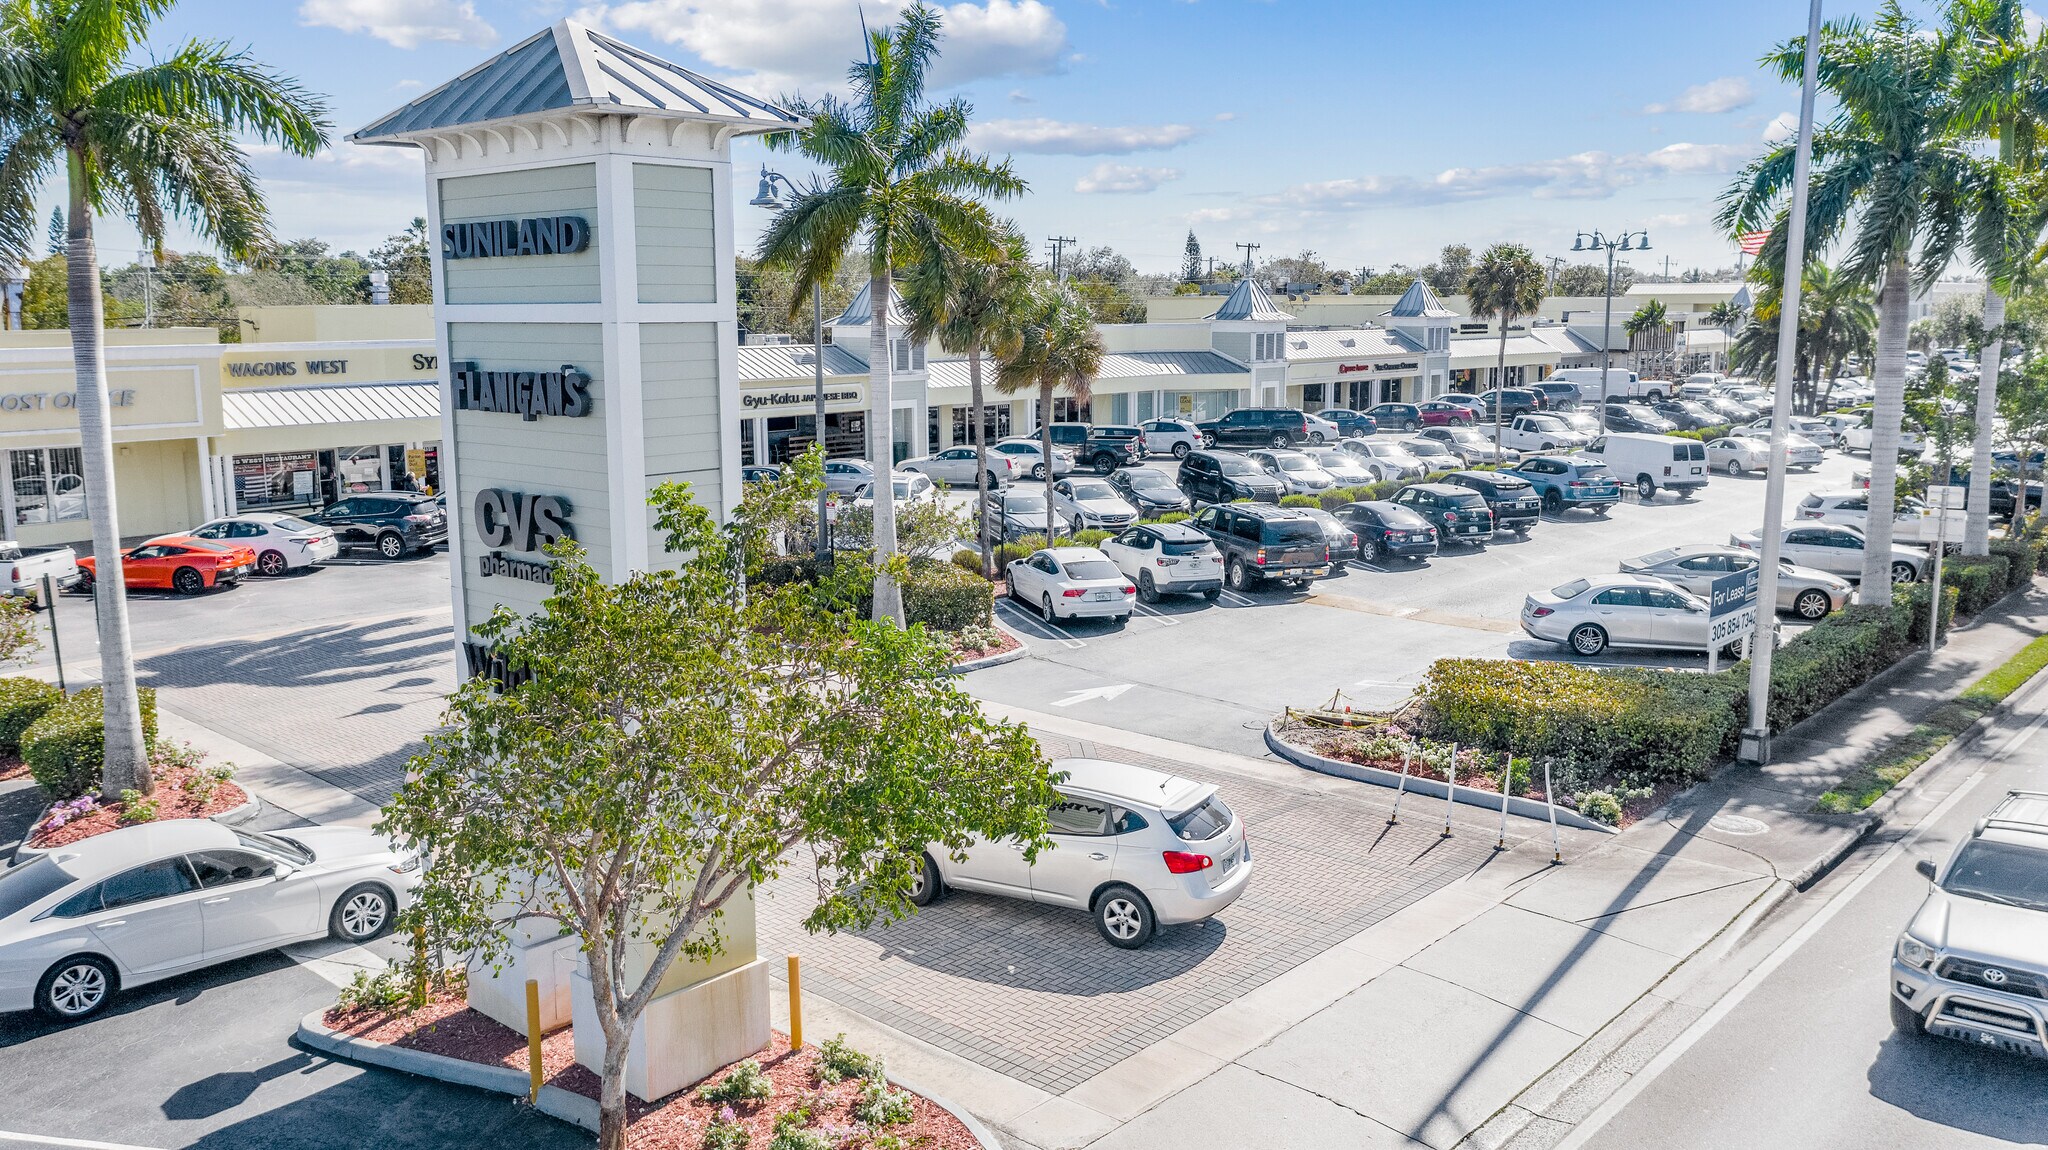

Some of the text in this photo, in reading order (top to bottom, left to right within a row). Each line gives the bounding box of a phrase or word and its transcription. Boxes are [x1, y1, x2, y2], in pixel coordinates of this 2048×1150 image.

[441, 215, 590, 259] SUNILAND
[228, 359, 349, 377] WAGONS WEST
[0, 393, 51, 412] OST
[450, 361, 592, 421] FLANIGAN'S
[743, 393, 800, 409] Gyu-Kaku
[840, 391, 858, 400] BBQ
[265, 454, 312, 462] RESTAURANT
[474, 488, 578, 557] CVS
[480, 552, 555, 585] pharmac
[1713, 586, 1745, 608] For Lease
[1711, 621, 1726, 642] 305
[1727, 617, 1740, 636] 854
